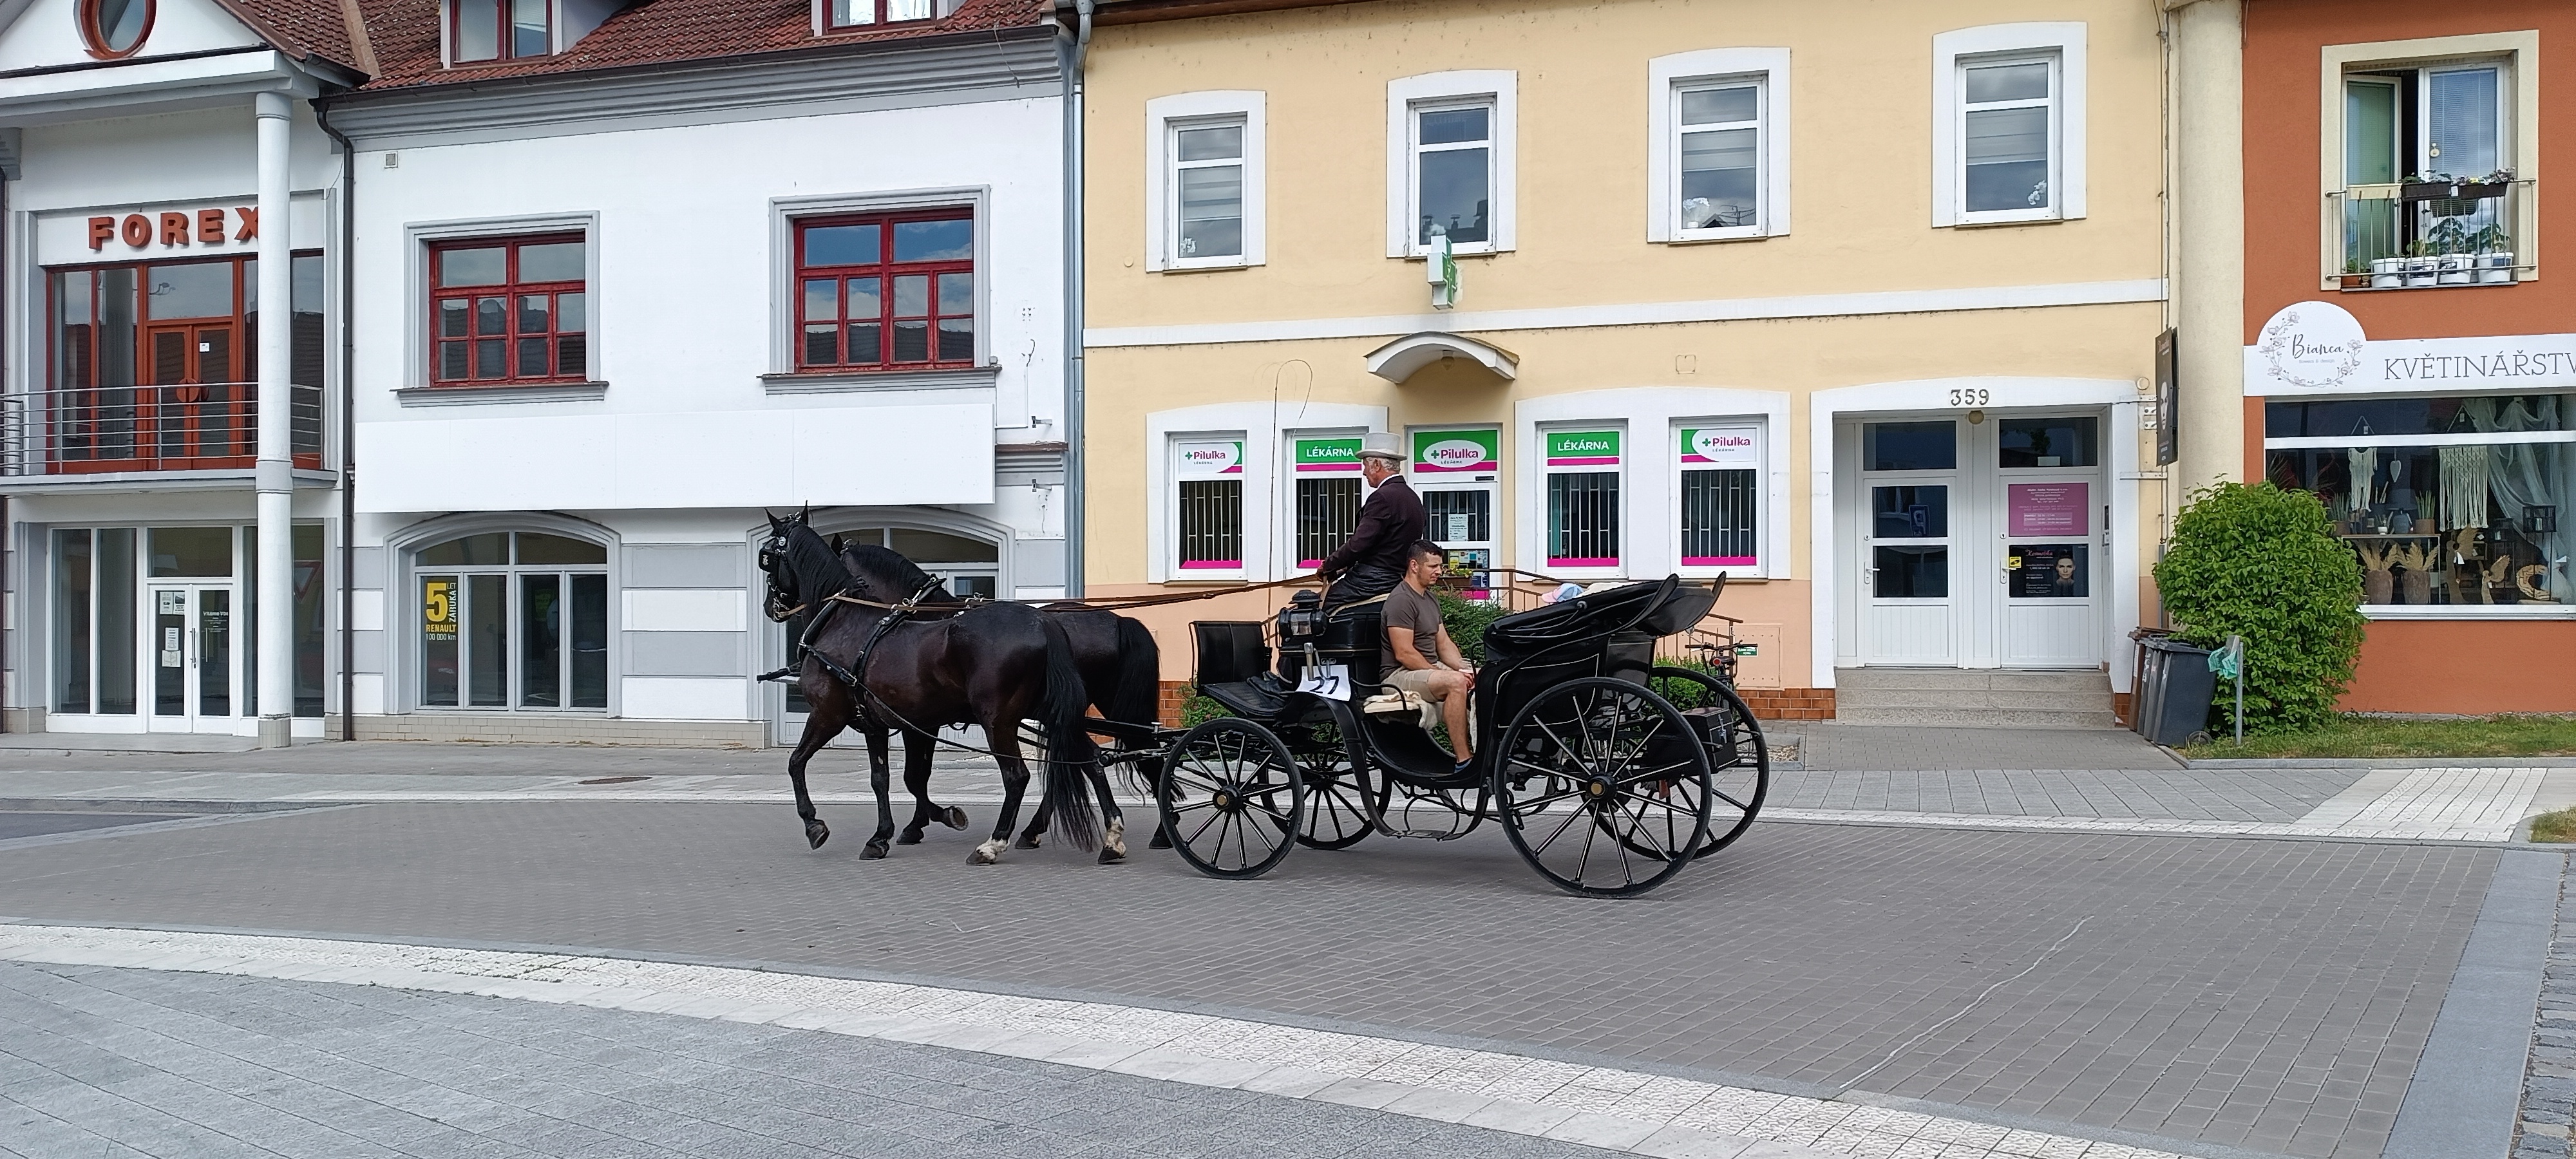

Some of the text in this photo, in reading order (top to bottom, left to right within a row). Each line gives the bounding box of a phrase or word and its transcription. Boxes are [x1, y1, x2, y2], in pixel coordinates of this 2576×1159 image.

[88, 206, 258, 251] FOREX
[2293, 334, 2344, 359] Bianca
[1950, 388, 1989, 406] 359
[1557, 438, 1610, 451] LÉKÁRNA
[1712, 437, 1750, 447] Pilulka
[1193, 450, 1226, 460] Pilulka
[1306, 446, 1354, 457] LÉKÁRNA
[1441, 448, 1479, 459] Pilulka
[426, 583, 448, 622] 5
[448, 590, 457, 623] ZÁRUKA
[426, 624, 457, 632] RENAULT
[1309, 675, 1340, 695] 27
